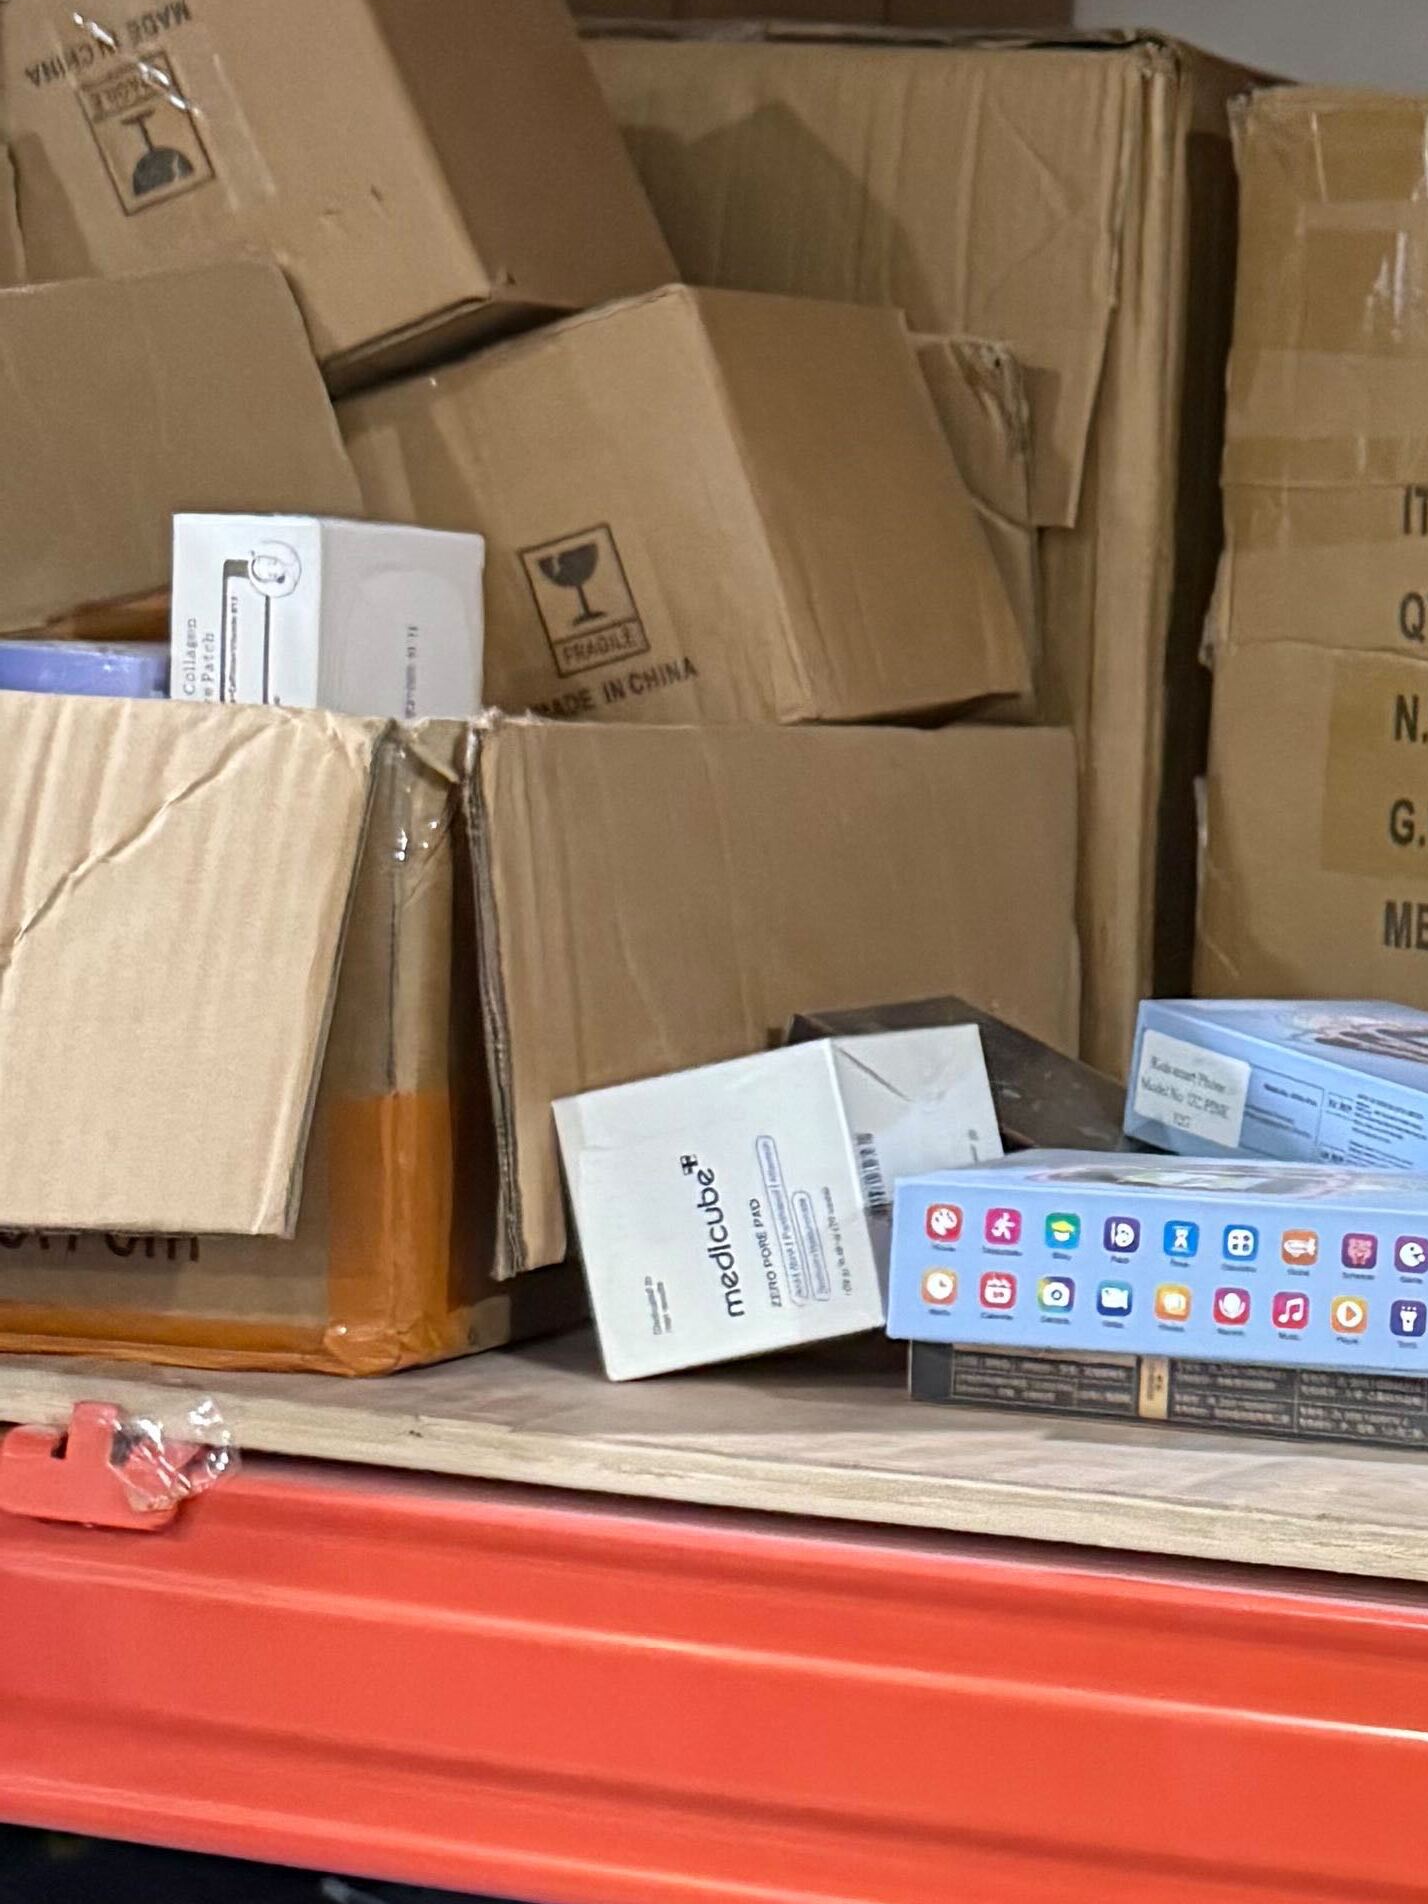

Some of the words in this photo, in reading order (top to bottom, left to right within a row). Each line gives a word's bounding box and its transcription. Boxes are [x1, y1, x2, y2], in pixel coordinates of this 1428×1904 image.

[603, 679, 626, 702] IN
[629, 657, 698, 695] CHINA
[696, 1167, 745, 1318] medicube
